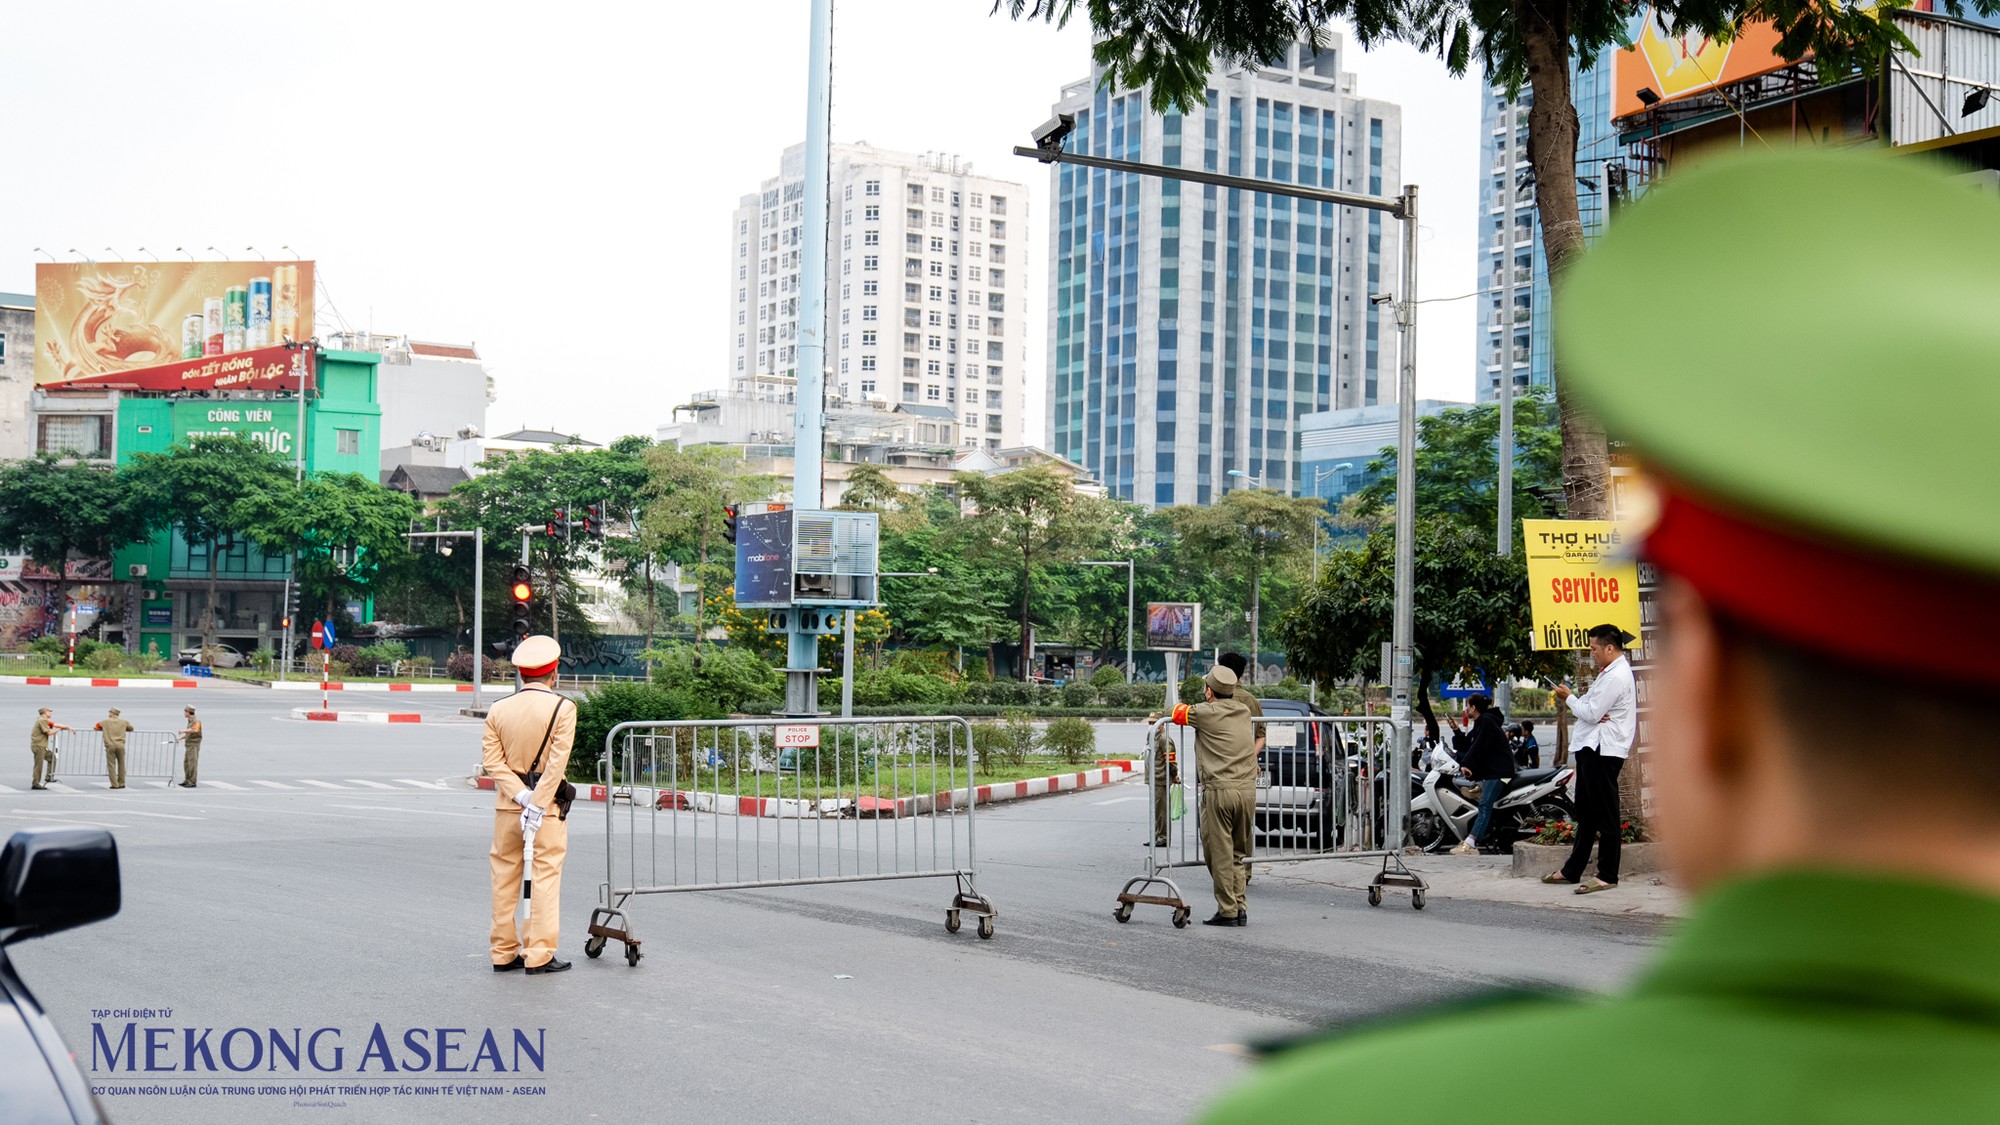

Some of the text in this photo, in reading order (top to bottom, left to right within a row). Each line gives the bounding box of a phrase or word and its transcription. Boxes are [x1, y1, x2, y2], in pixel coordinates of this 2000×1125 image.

[201, 361, 221, 377] TẾT
[239, 367, 258, 383] BỘI
[260, 363, 285, 380] LỘC
[207, 408, 272, 422] CÔNG VIÊN
[1539, 528, 1621, 546] THỢ HUẾ
[747, 553, 780, 562] mobifone
[1552, 572, 1620, 603] service
[1544, 620, 1562, 648] lối
